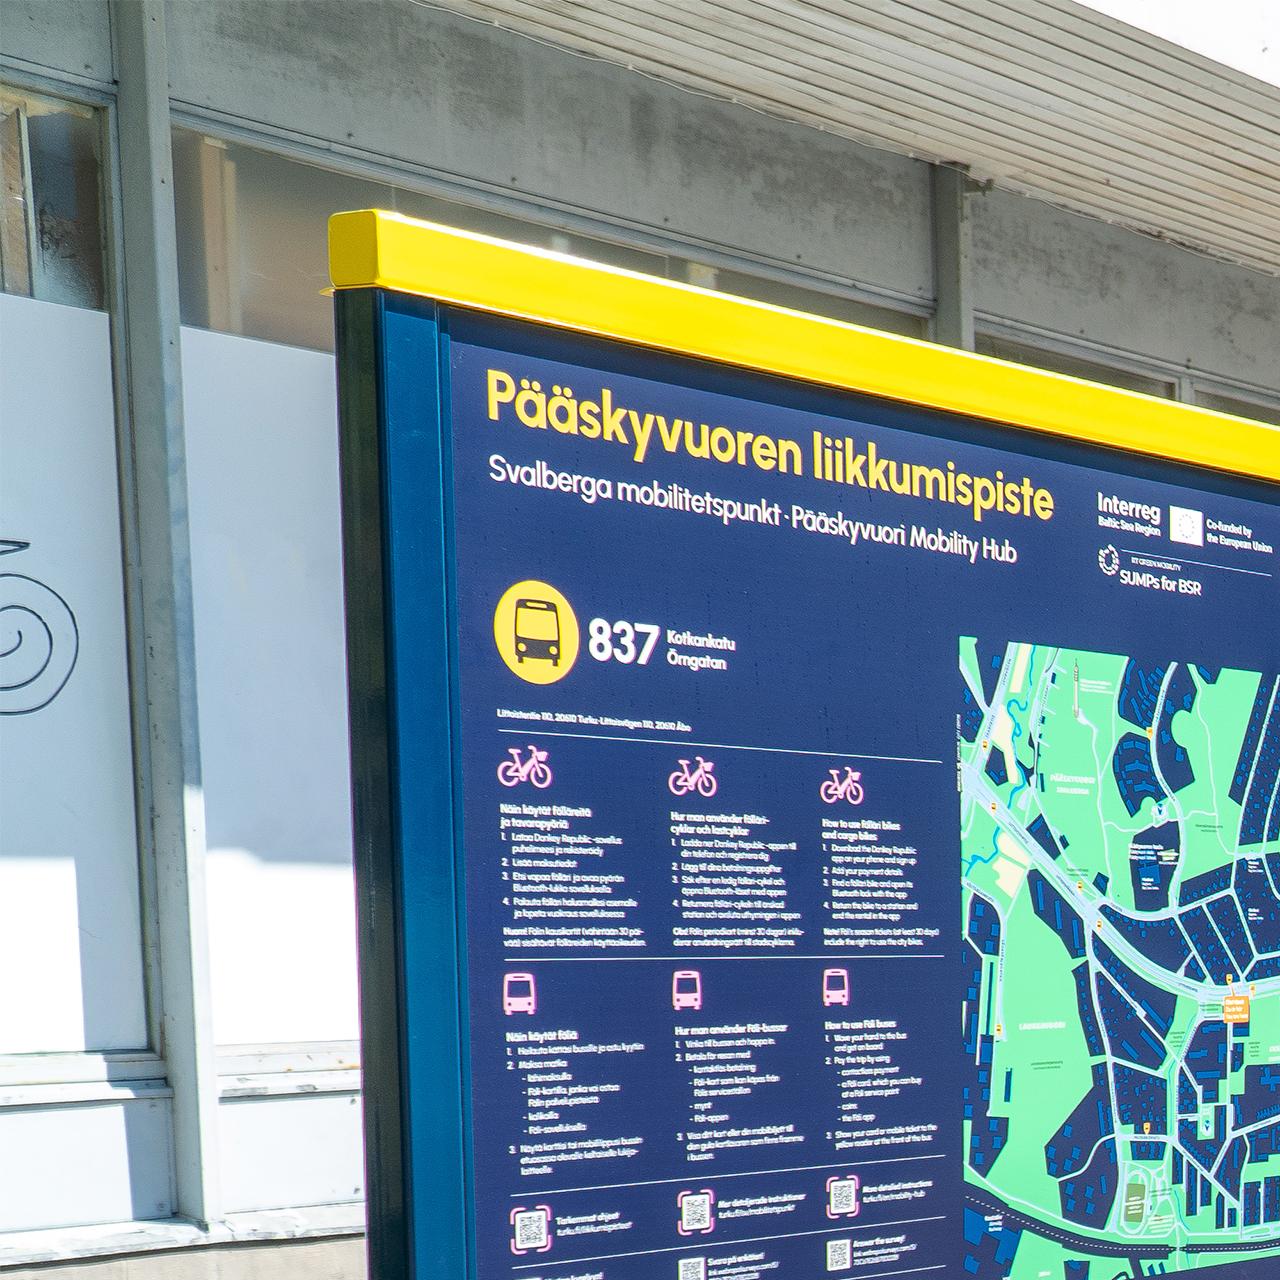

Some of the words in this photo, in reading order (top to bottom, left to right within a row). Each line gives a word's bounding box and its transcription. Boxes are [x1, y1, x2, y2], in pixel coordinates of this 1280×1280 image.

[487, 369, 802, 476] Pääskyvuoren
[813, 431, 1054, 521] liikkumispiste
[489, 454, 612, 504] Svalberga
[617, 480, 781, 526] mobilitetspunkt
[792, 504, 905, 545] Pääskyvuori
[910, 525, 978, 563] Mobility
[982, 536, 1018, 564] Hub
[1097, 492, 1161, 525] Interreg
[1098, 515, 1121, 530] Baltic
[1120, 520, 1135, 532] Sea
[1134, 522, 1162, 537] Region
[1206, 518, 1243, 535] Co-funded
[1243, 525, 1253, 539] by
[1207, 532, 1219, 544] the
[1219, 534, 1253, 550] European
[1252, 542, 1273, 554] Union
[1119, 569, 1160, 590] SUMPs
[1161, 576, 1178, 592] for
[1178, 579, 1202, 596] BSR
[588, 617, 661, 665] 837
[667, 629, 736, 651] Kotkankatu
[667, 647, 727, 671] Örngatan
